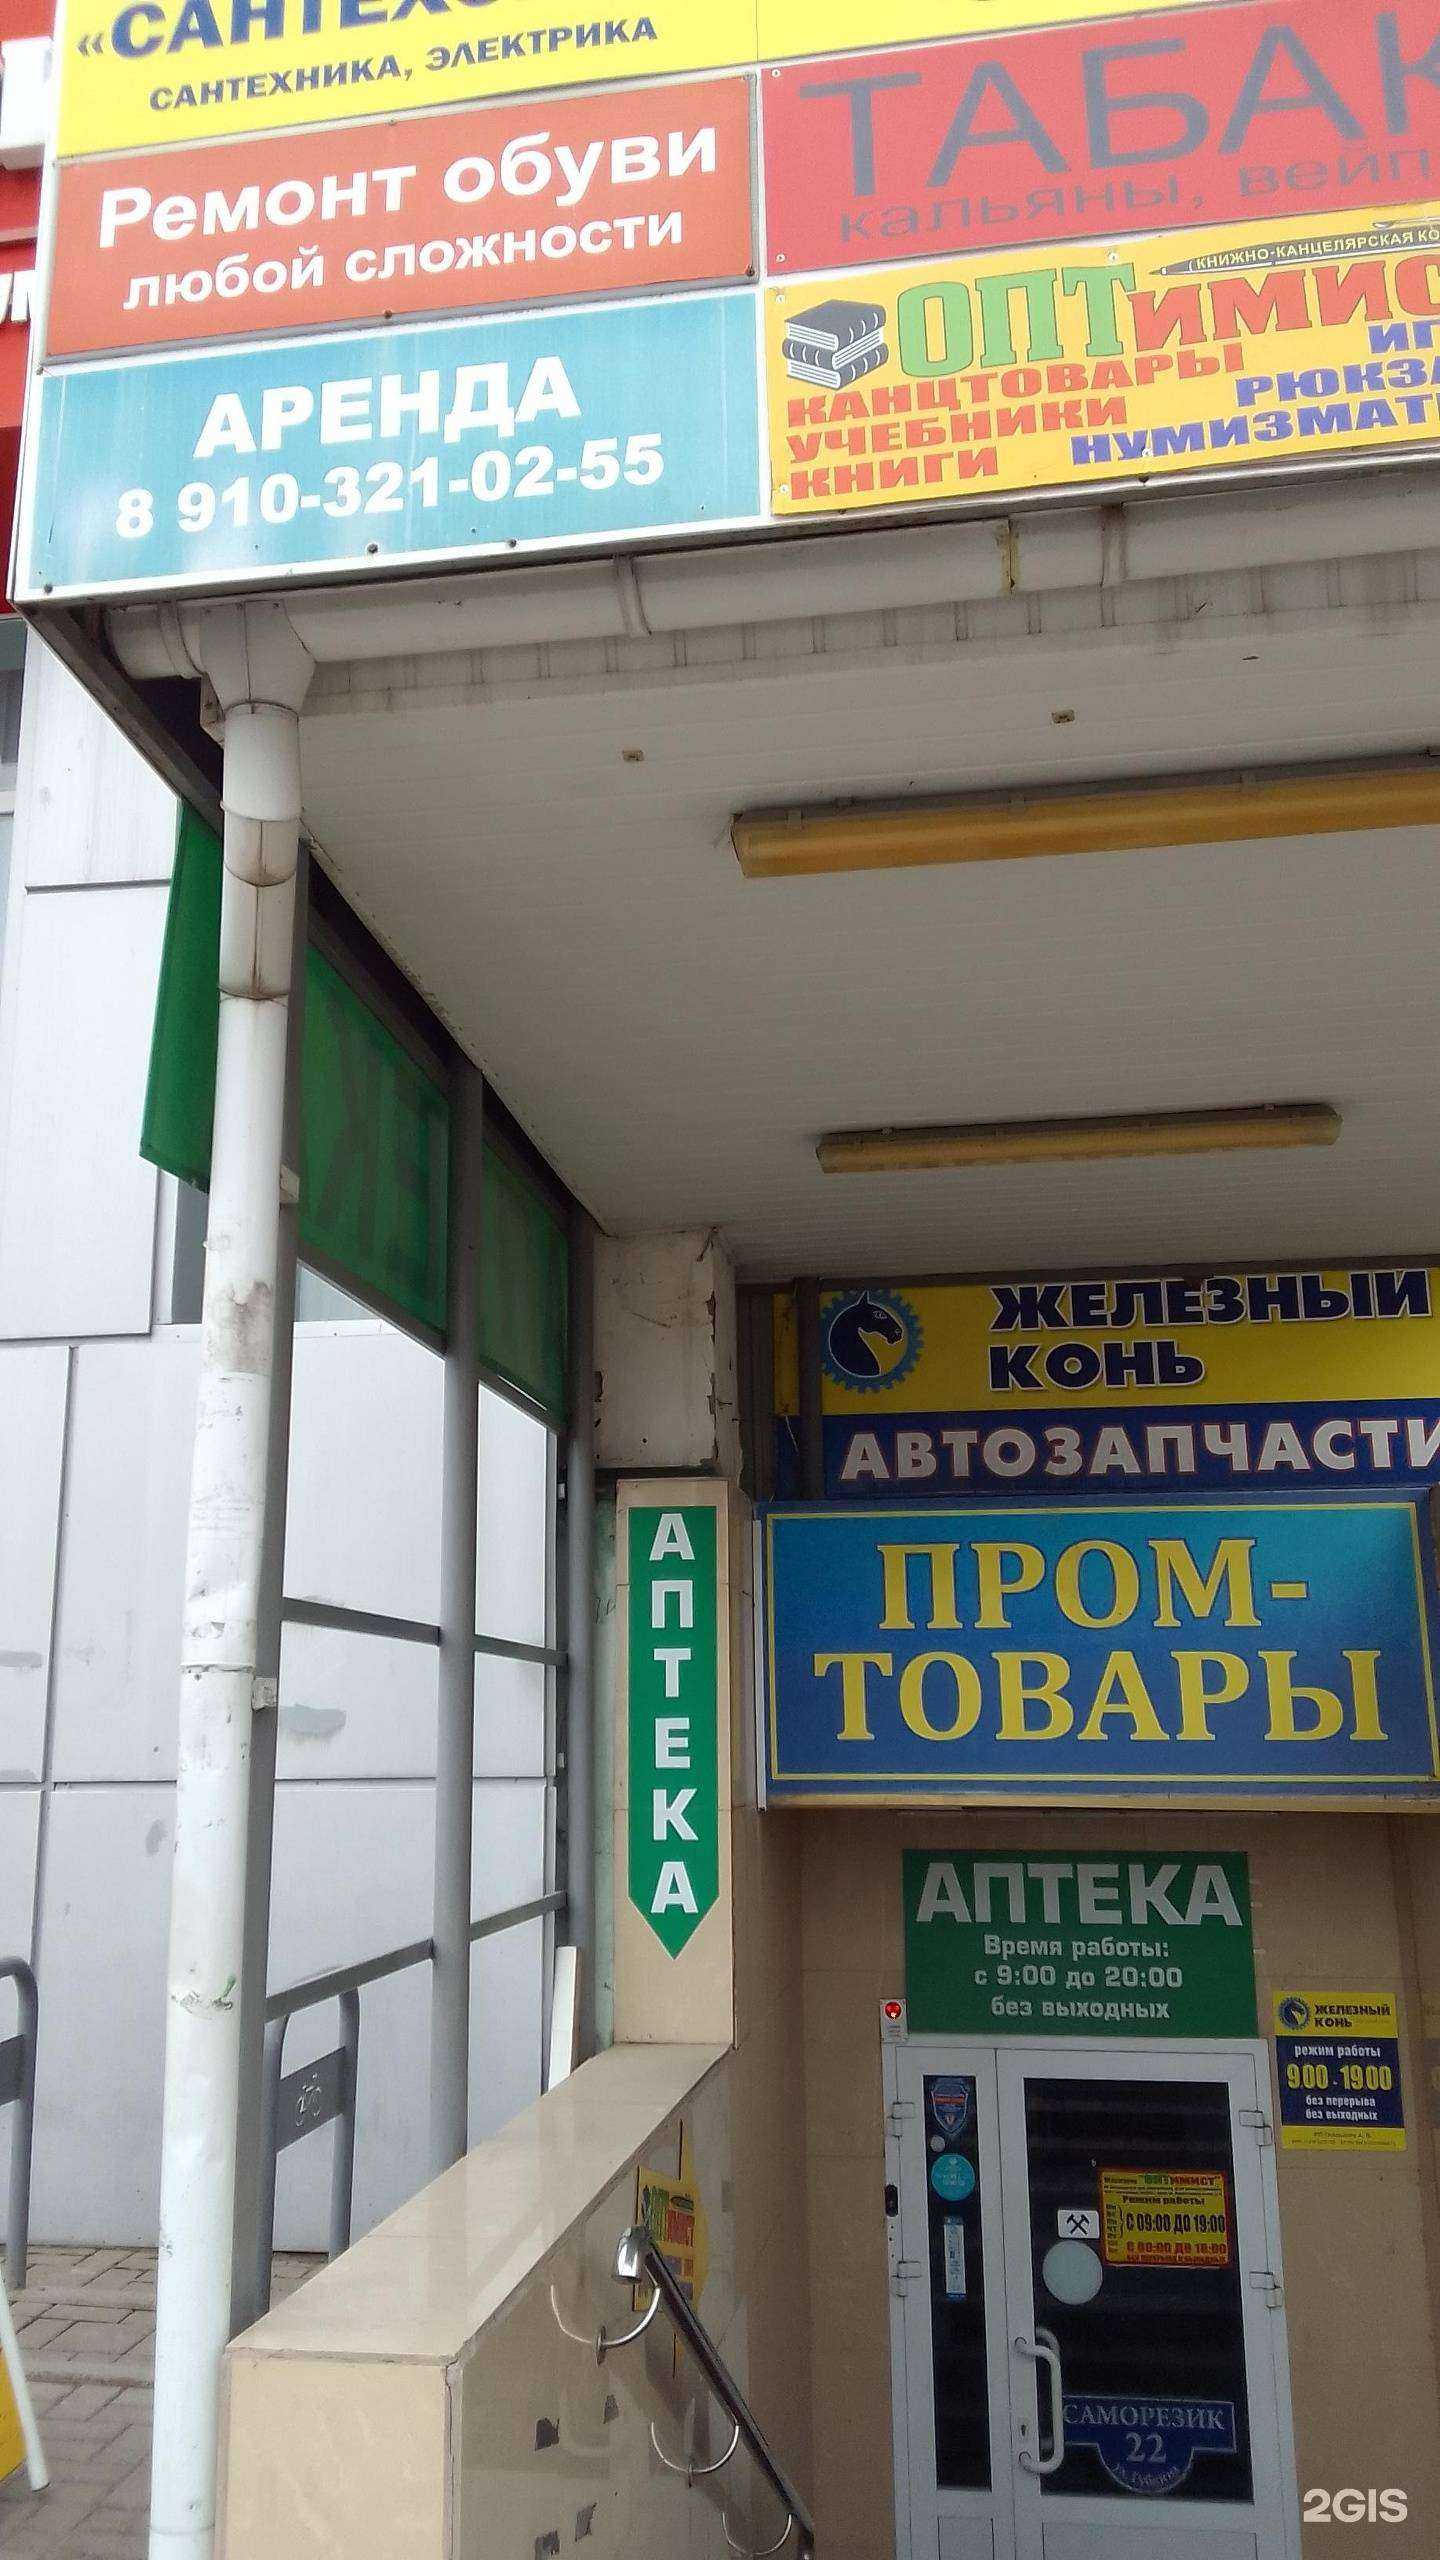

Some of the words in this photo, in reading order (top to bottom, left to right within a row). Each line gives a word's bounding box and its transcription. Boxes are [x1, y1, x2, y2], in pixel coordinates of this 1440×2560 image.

[150, 54, 413, 112] САНТЕХНИКА,
[425, 16, 658, 72] ЭЛЕКТРИКА
[99, 166, 417, 249] Ремонт
[442, 127, 718, 209] обуви
[840, 174, 1205, 243] кальяны,
[122, 246, 325, 311] любой
[344, 210, 683, 283] сложности
[1195, 230, 1414, 271] КНИЖНО-КАНЦЕЛЯРСКАЯ
[193, 356, 582, 458] АРЕНДА
[787, 343, 1245, 428] КАНЦТОВАРЫ
[1235, 354, 1440, 408] РЮКЗ
[786, 396, 1128, 464] УЧЕБНИКИ
[1070, 392, 1440, 466] НУМИЗМАТ
[116, 488, 154, 540] 8
[177, 433, 665, 534] 910-321-02-55
[790, 446, 999, 501] КНИГИ
[988, 1341, 1206, 1391] КОНЬ
[840, 1418, 1440, 1481] АВТОЗАПЧАСТИ
[875, 1538, 1310, 1631] ПРОМ-
[648, 1512, 700, 1915] АПТЕКА
[813, 1649, 1389, 1742] ТОВАРЫ
[916, 1862, 1243, 1928] АПТЕКА
[974, 1969, 988, 1986] с
[996, 1965, 1056, 1987] 9:00
[1065, 1971, 1095, 1990] до
[1104, 1966, 1184, 1988] 20:00
[984, 1934, 1063, 1961] Время
[1072, 1936, 1169, 1962] работы:
[991, 1995, 1033, 2017] без
[1041, 2000, 1171, 2022] выходных
[1315, 2003, 1391, 2016] ЖЕЛЕЗНЫЙ
[1315, 2018, 1353, 2028] КОНЬ
[1294, 2045, 1334, 2058] режим
[1338, 2044, 1381, 2059] работы
[1306, 2094, 1323, 2106] без
[1306, 2108, 1323, 2120] без
[1326, 2110, 1378, 2122] выходных
[1126, 2432, 1167, 2463] 22
